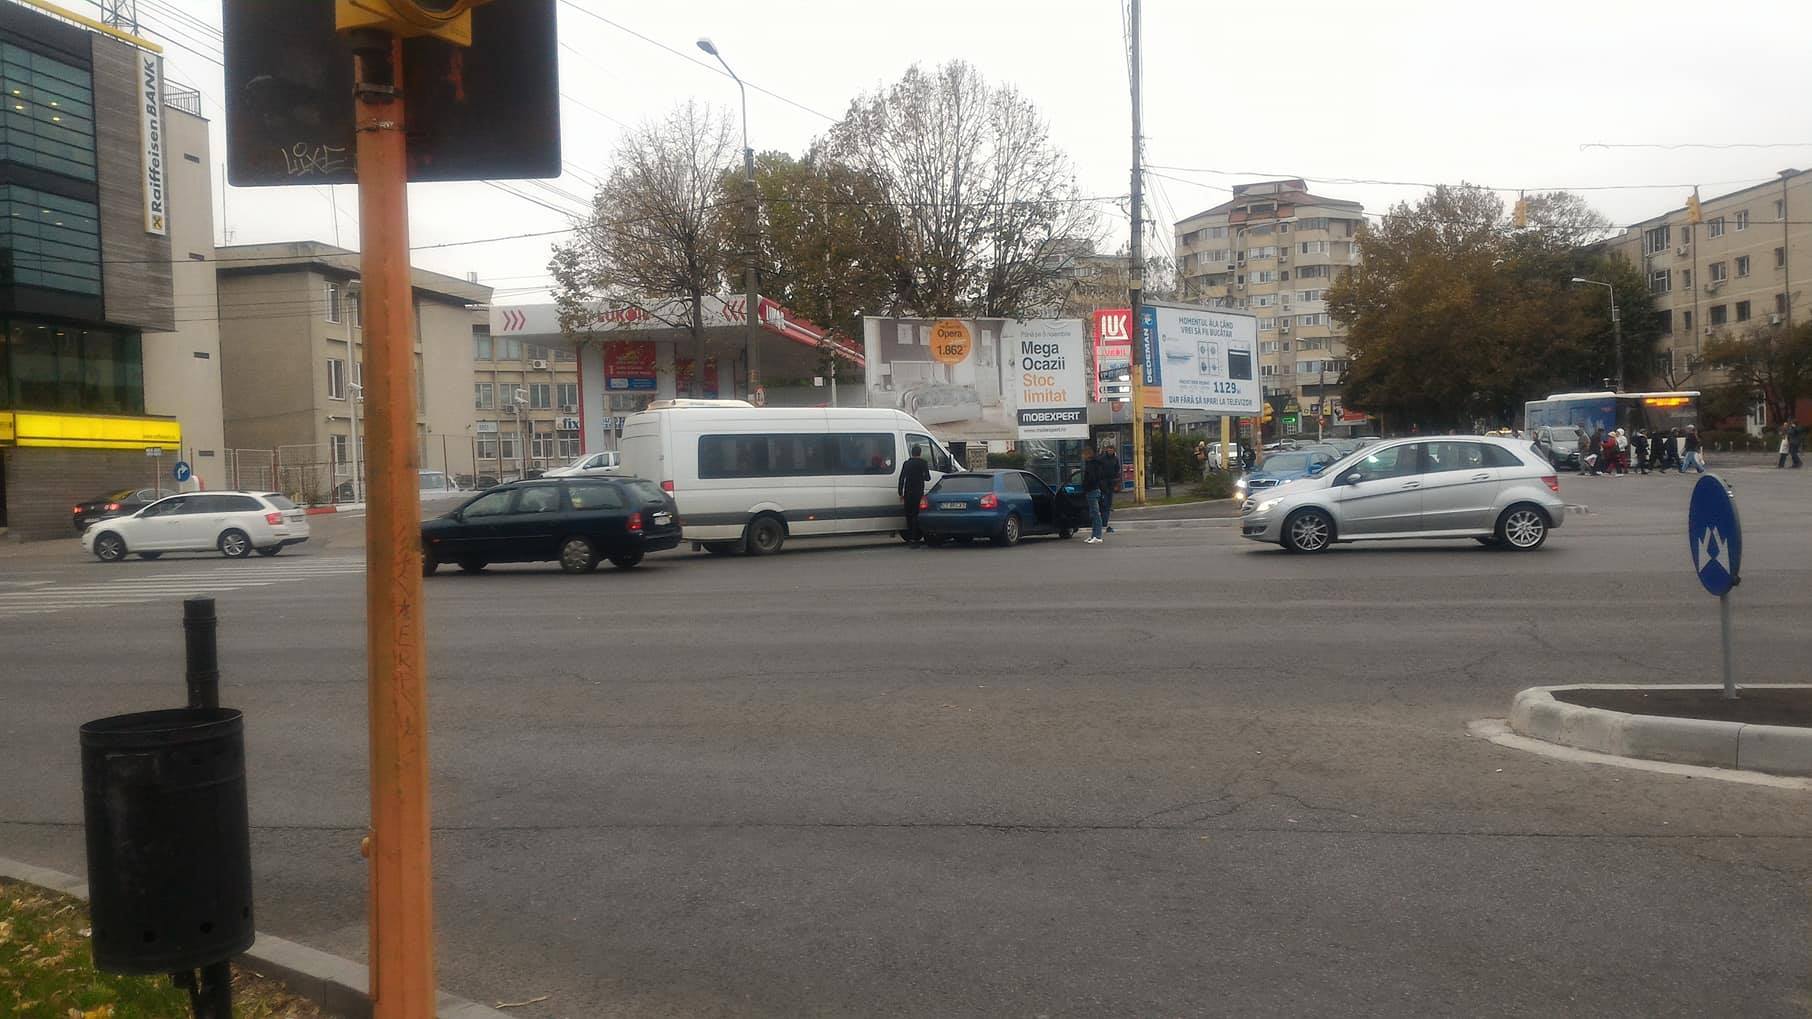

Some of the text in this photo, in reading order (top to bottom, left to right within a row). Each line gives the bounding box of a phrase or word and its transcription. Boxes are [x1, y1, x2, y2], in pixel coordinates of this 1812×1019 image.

[143, 57, 163, 213] Raiffeisen BANK
[936, 329, 962, 339] Opera
[936, 344, 964, 356] 1.862
[1021, 340, 1059, 358] Mega
[1143, 328, 1153, 384] DEDEMAN
[1022, 356, 1066, 371] Ocazii
[1023, 372, 1056, 387] Stoc
[1213, 381, 1237, 394] 1129
[1023, 389, 1067, 404] limitat
[1022, 411, 1081, 422] MOBEXPERT
